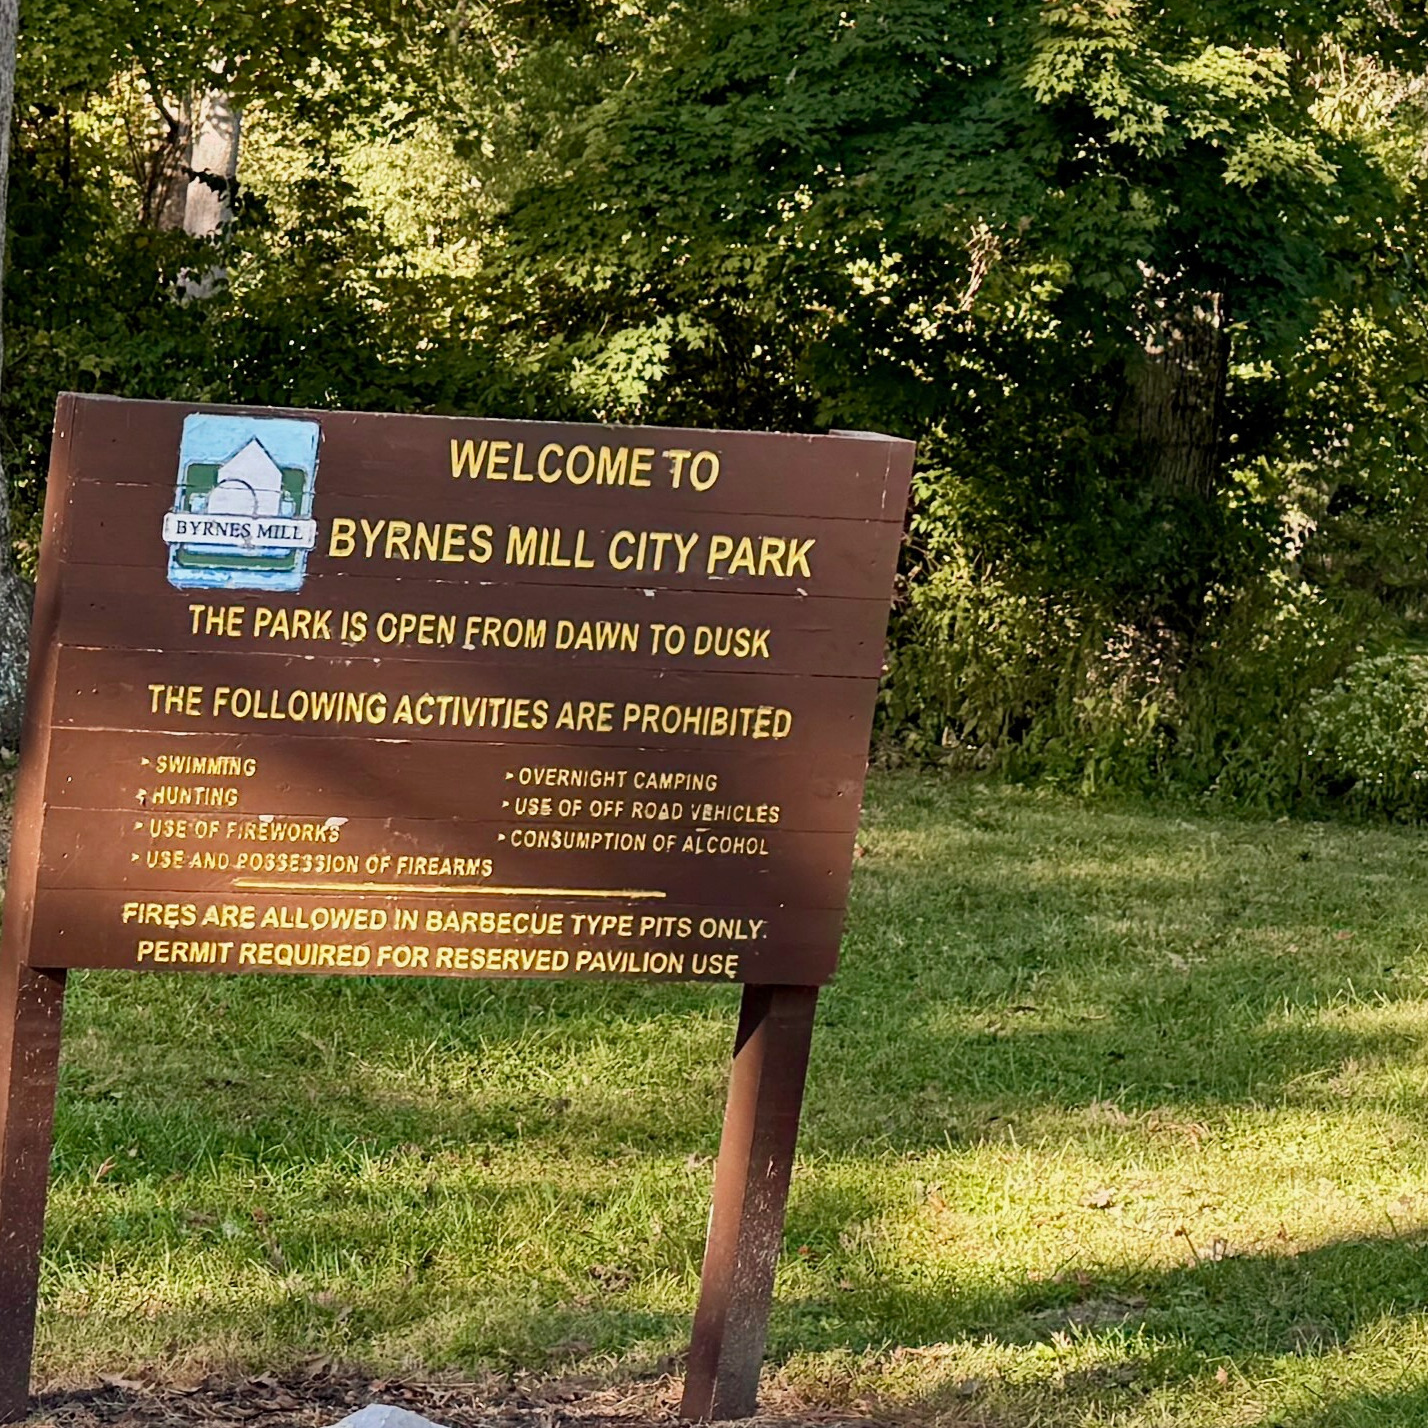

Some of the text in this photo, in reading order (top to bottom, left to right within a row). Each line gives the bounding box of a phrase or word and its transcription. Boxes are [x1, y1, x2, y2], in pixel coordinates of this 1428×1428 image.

[450, 438, 721, 491] WELCOME TO
[176, 520, 303, 540] BYRNES MILL
[328, 517, 816, 578] BYRNES MILL CITY PARK
[189, 604, 771, 658] THE PARK IS OPEN FROM DAWN TO DUSK
[148, 684, 793, 739] THE FOLLOWING ACTIVITIES ARE PROHIBITED
[155, 755, 257, 777] SWIMMING
[518, 767, 718, 792] OVERNIGHT CAMPING
[152, 786, 239, 806] HUNTING
[514, 798, 781, 824] USE OF OFF ROAD VEHICLES
[150, 819, 340, 843] USE OF FIREWORKS
[510, 829, 770, 856] CONSUMPTION OF ALCOHOL
[147, 850, 493, 877] USE AND POSSESSION OF FIREARMS
[122, 902, 197, 929] FIRES
[202, 904, 256, 930] ARE
[260, 905, 387, 931] ALLOWED
[394, 909, 419, 932] IN
[425, 910, 564, 936] BARBECUE
[570, 914, 633, 937] TYPE
[640, 916, 692, 939] PITS
[137, 940, 739, 979] PERMIT REQUIRED FOR RESERVED PAVILION USE
